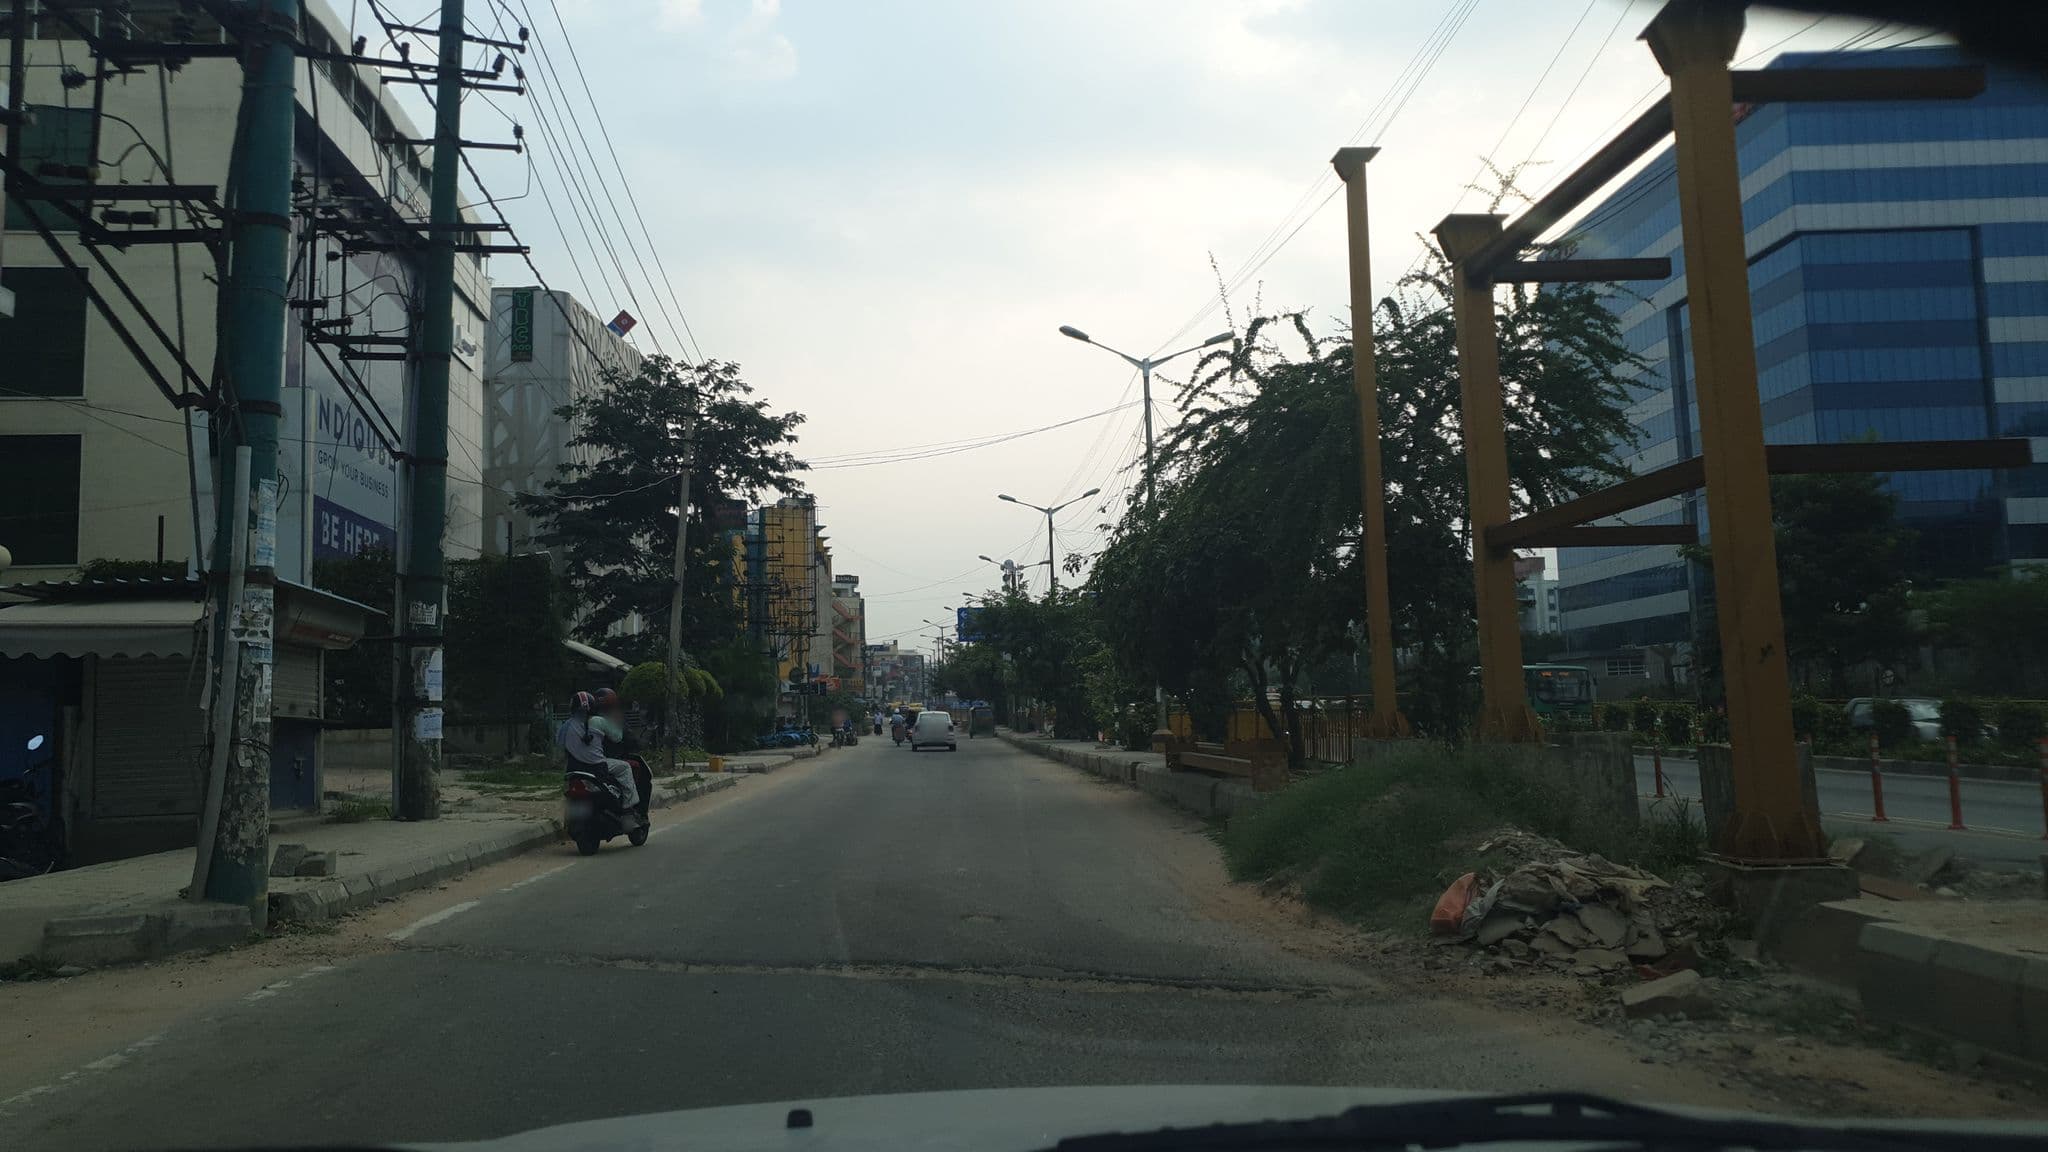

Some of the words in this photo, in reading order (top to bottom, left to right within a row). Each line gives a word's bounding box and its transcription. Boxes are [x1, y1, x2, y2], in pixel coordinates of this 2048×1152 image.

[341, 461, 359, 482] YOUR
[359, 471, 389, 499] BUSINESS
[321, 511, 340, 549] BE
